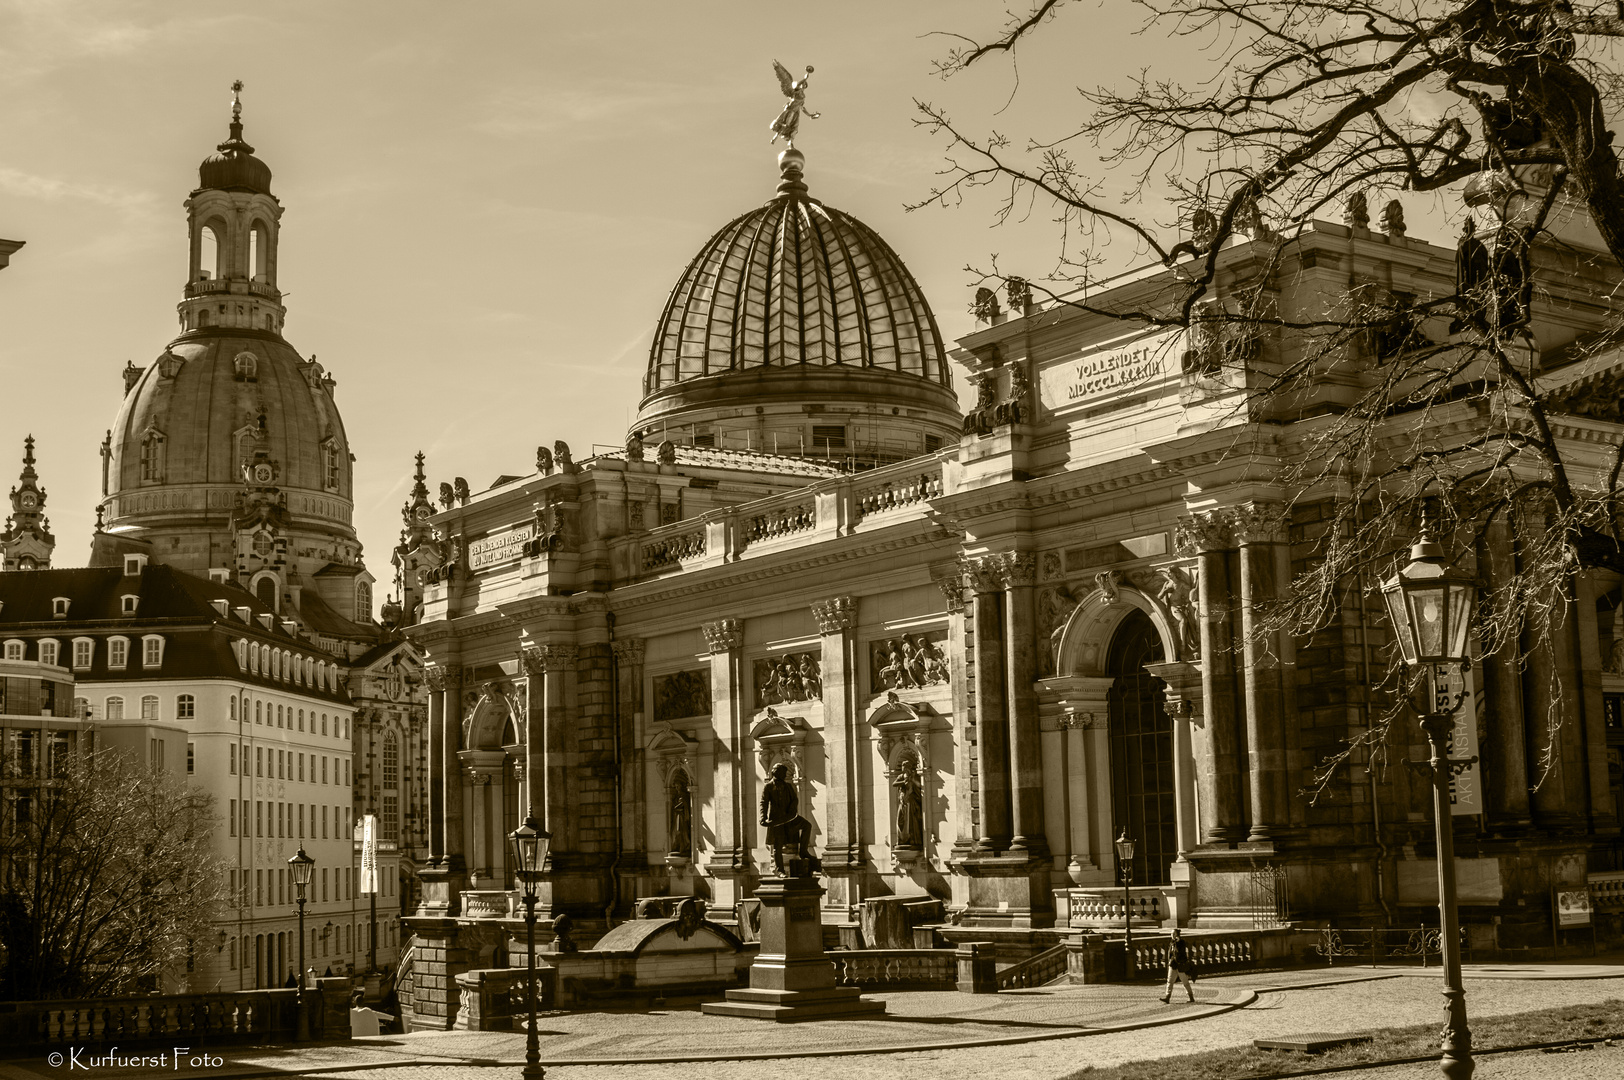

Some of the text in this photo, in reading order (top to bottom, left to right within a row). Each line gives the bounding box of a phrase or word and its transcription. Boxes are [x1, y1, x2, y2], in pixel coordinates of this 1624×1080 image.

[1077, 347, 1149, 379] VOLLENDET
[472, 530, 530, 556] DEN BILDENDEN KUENSTEN
[474, 555, 481, 567] ZU
[494, 549, 503, 562] UND
